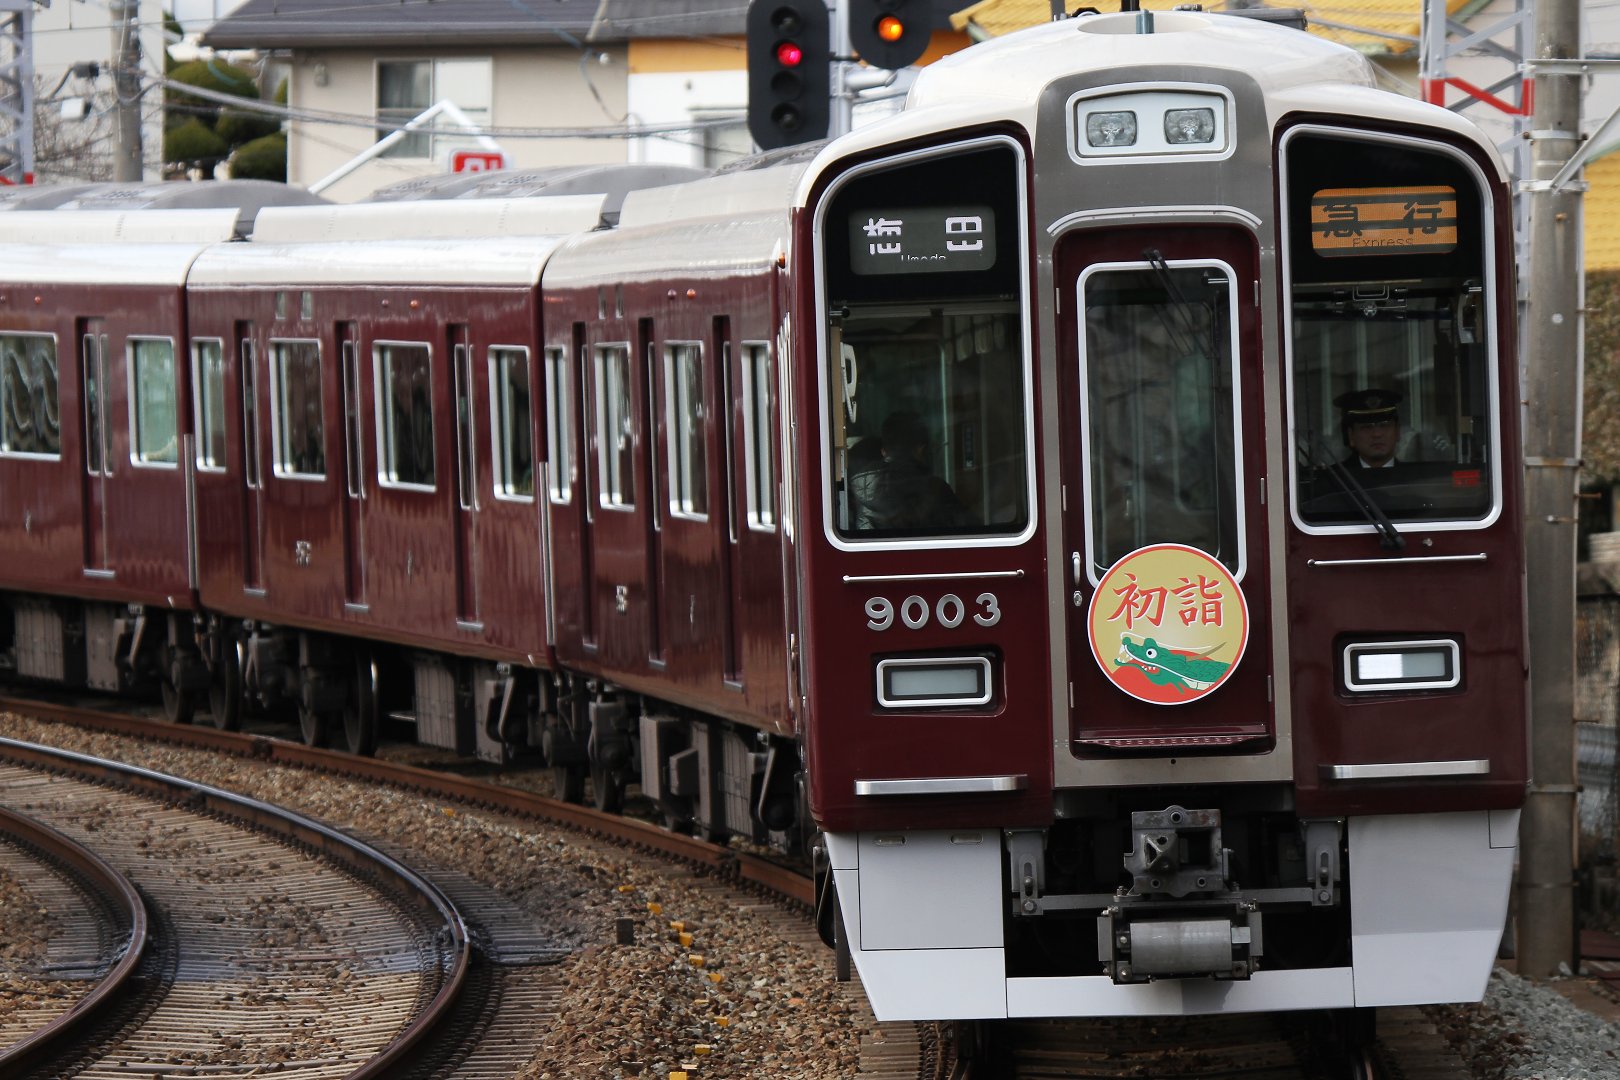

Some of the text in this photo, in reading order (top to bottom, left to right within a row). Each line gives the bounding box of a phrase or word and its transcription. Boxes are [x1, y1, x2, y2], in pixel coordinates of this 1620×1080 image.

[863, 215, 983, 256] 梅田
[1322, 200, 1443, 239] 急行
[864, 592, 1002, 632] 9003
[1106, 572, 1225, 630] 初詣
